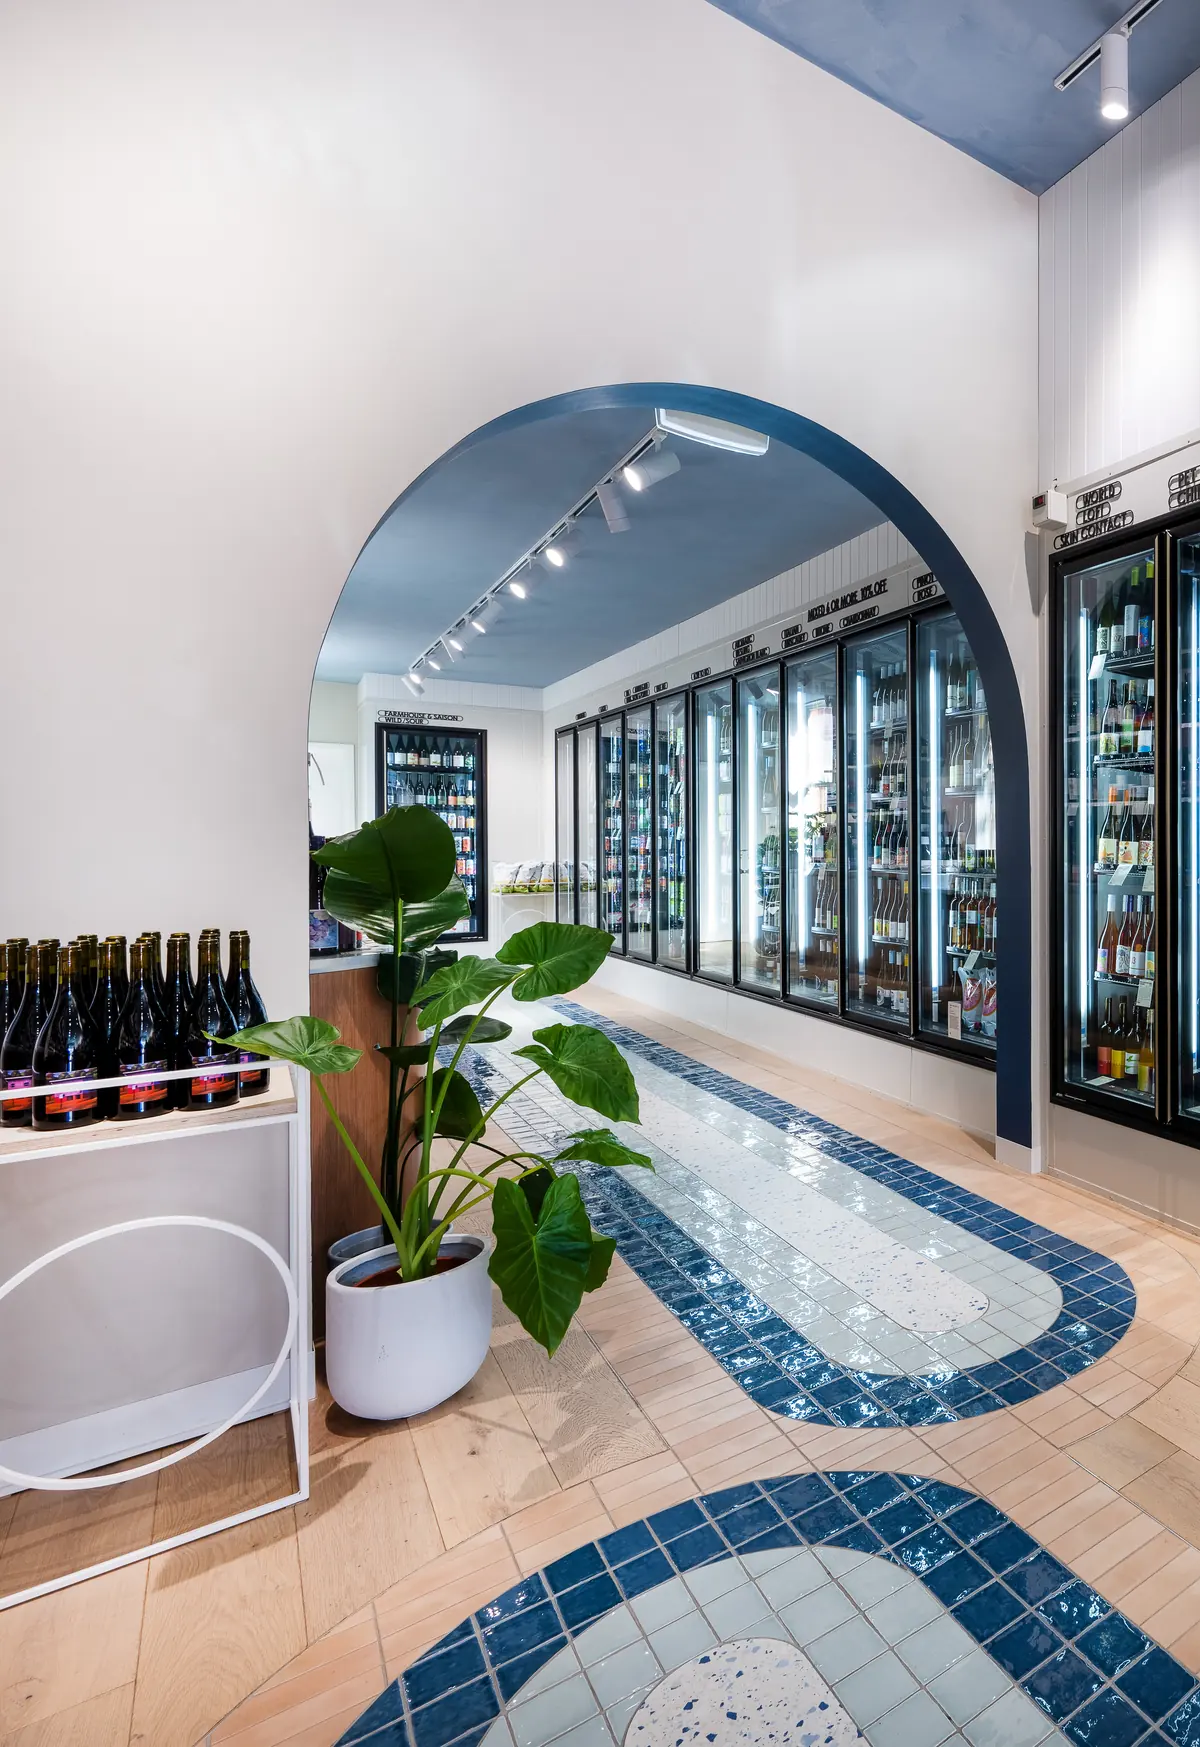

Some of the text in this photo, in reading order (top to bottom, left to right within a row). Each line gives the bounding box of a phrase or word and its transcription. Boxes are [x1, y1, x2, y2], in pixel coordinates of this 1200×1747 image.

[1178, 468, 1197, 488] PET
[1082, 483, 1115, 508] WORLD
[1060, 513, 1127, 549] SKIN CONTACT
[385, 711, 425, 719] FARMHOUSE
